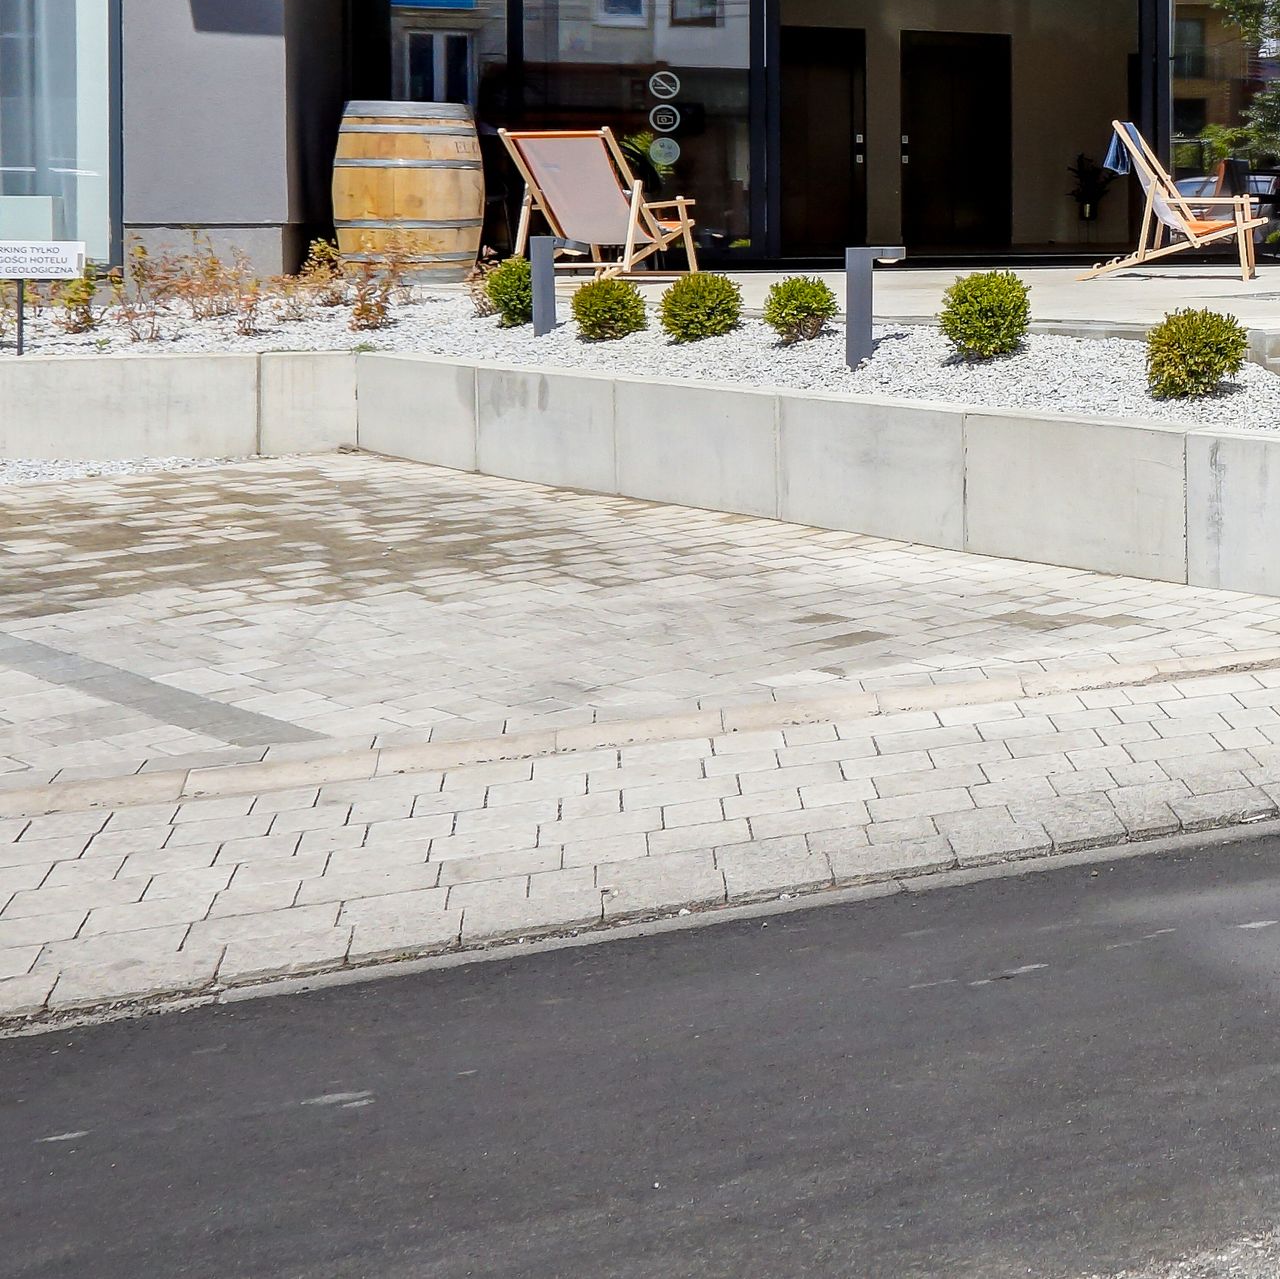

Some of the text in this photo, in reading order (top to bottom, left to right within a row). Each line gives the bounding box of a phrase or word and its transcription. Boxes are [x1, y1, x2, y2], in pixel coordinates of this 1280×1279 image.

[30, 246, 60, 254] TYLKO
[30, 256, 68, 264] HOTELU
[5, 266, 74, 274] GEOLOGICZNA
